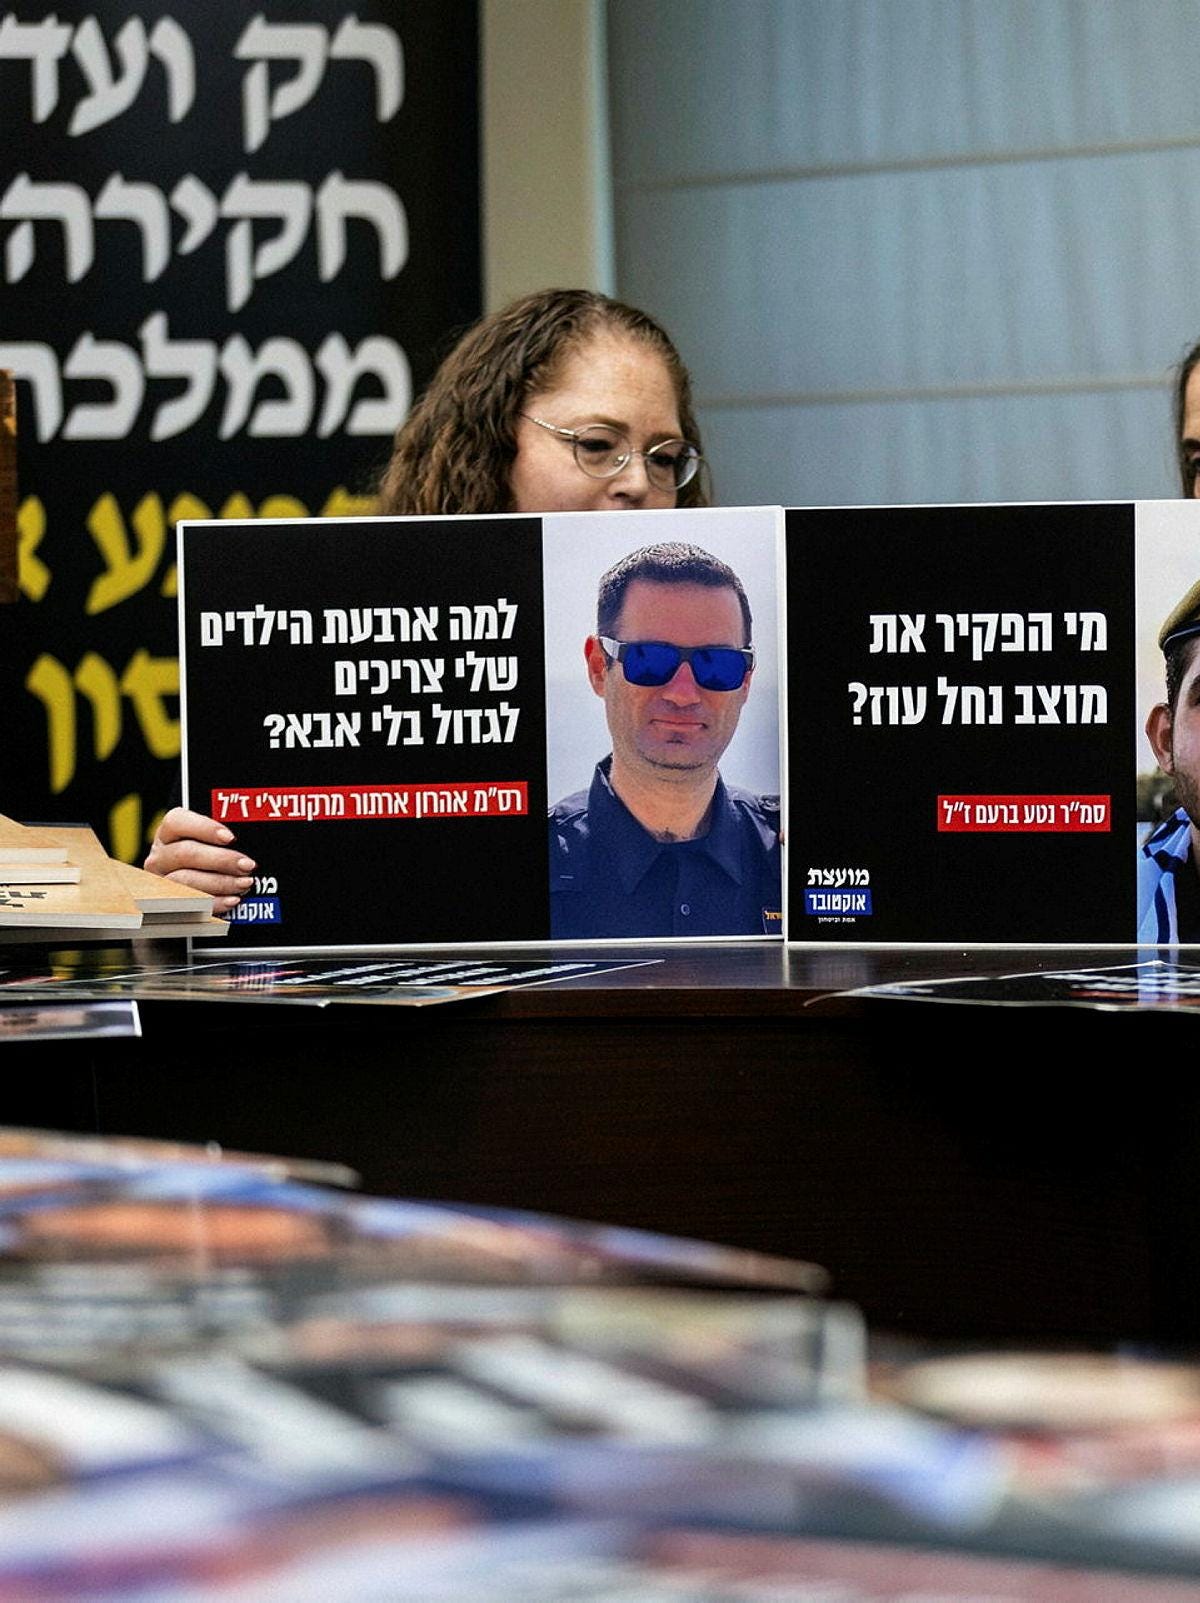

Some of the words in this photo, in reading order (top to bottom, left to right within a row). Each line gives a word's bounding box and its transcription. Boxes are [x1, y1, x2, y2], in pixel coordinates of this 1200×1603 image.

[233, 13, 404, 154] רק
[0, 170, 409, 314] חקירה
[200, 603, 313, 647] הילדים
[321, 606, 439, 645] ארבעת
[449, 597, 519, 641] למה
[869, 613, 927, 654] את
[935, 612, 1053, 662] הפקיר
[1063, 612, 1108, 652] מי
[334, 658, 445, 696] צריכים
[454, 650, 519, 692] שלי
[847, 681, 928, 726] עוז?
[937, 676, 1003, 725] נחל
[1014, 684, 1108, 725] מוצב
[263, 711, 361, 749] אבא?
[371, 704, 424, 746] בלי
[432, 701, 521, 745] לגדול
[217, 792, 250, 819] ז"ל
[349, 791, 409, 816] ארתור
[415, 789, 468, 819] אהרון
[473, 786, 522, 813] רס"מ
[943, 799, 972, 824] ז"ל
[975, 804, 1020, 824] ברעם
[1023, 804, 1055, 824] נטע
[1059, 801, 1106, 824] סמ"ר
[807, 867, 870, 888] מועצת
[224, 902, 275, 922] אוקטו
[808, 893, 866, 913] אוקטובר
